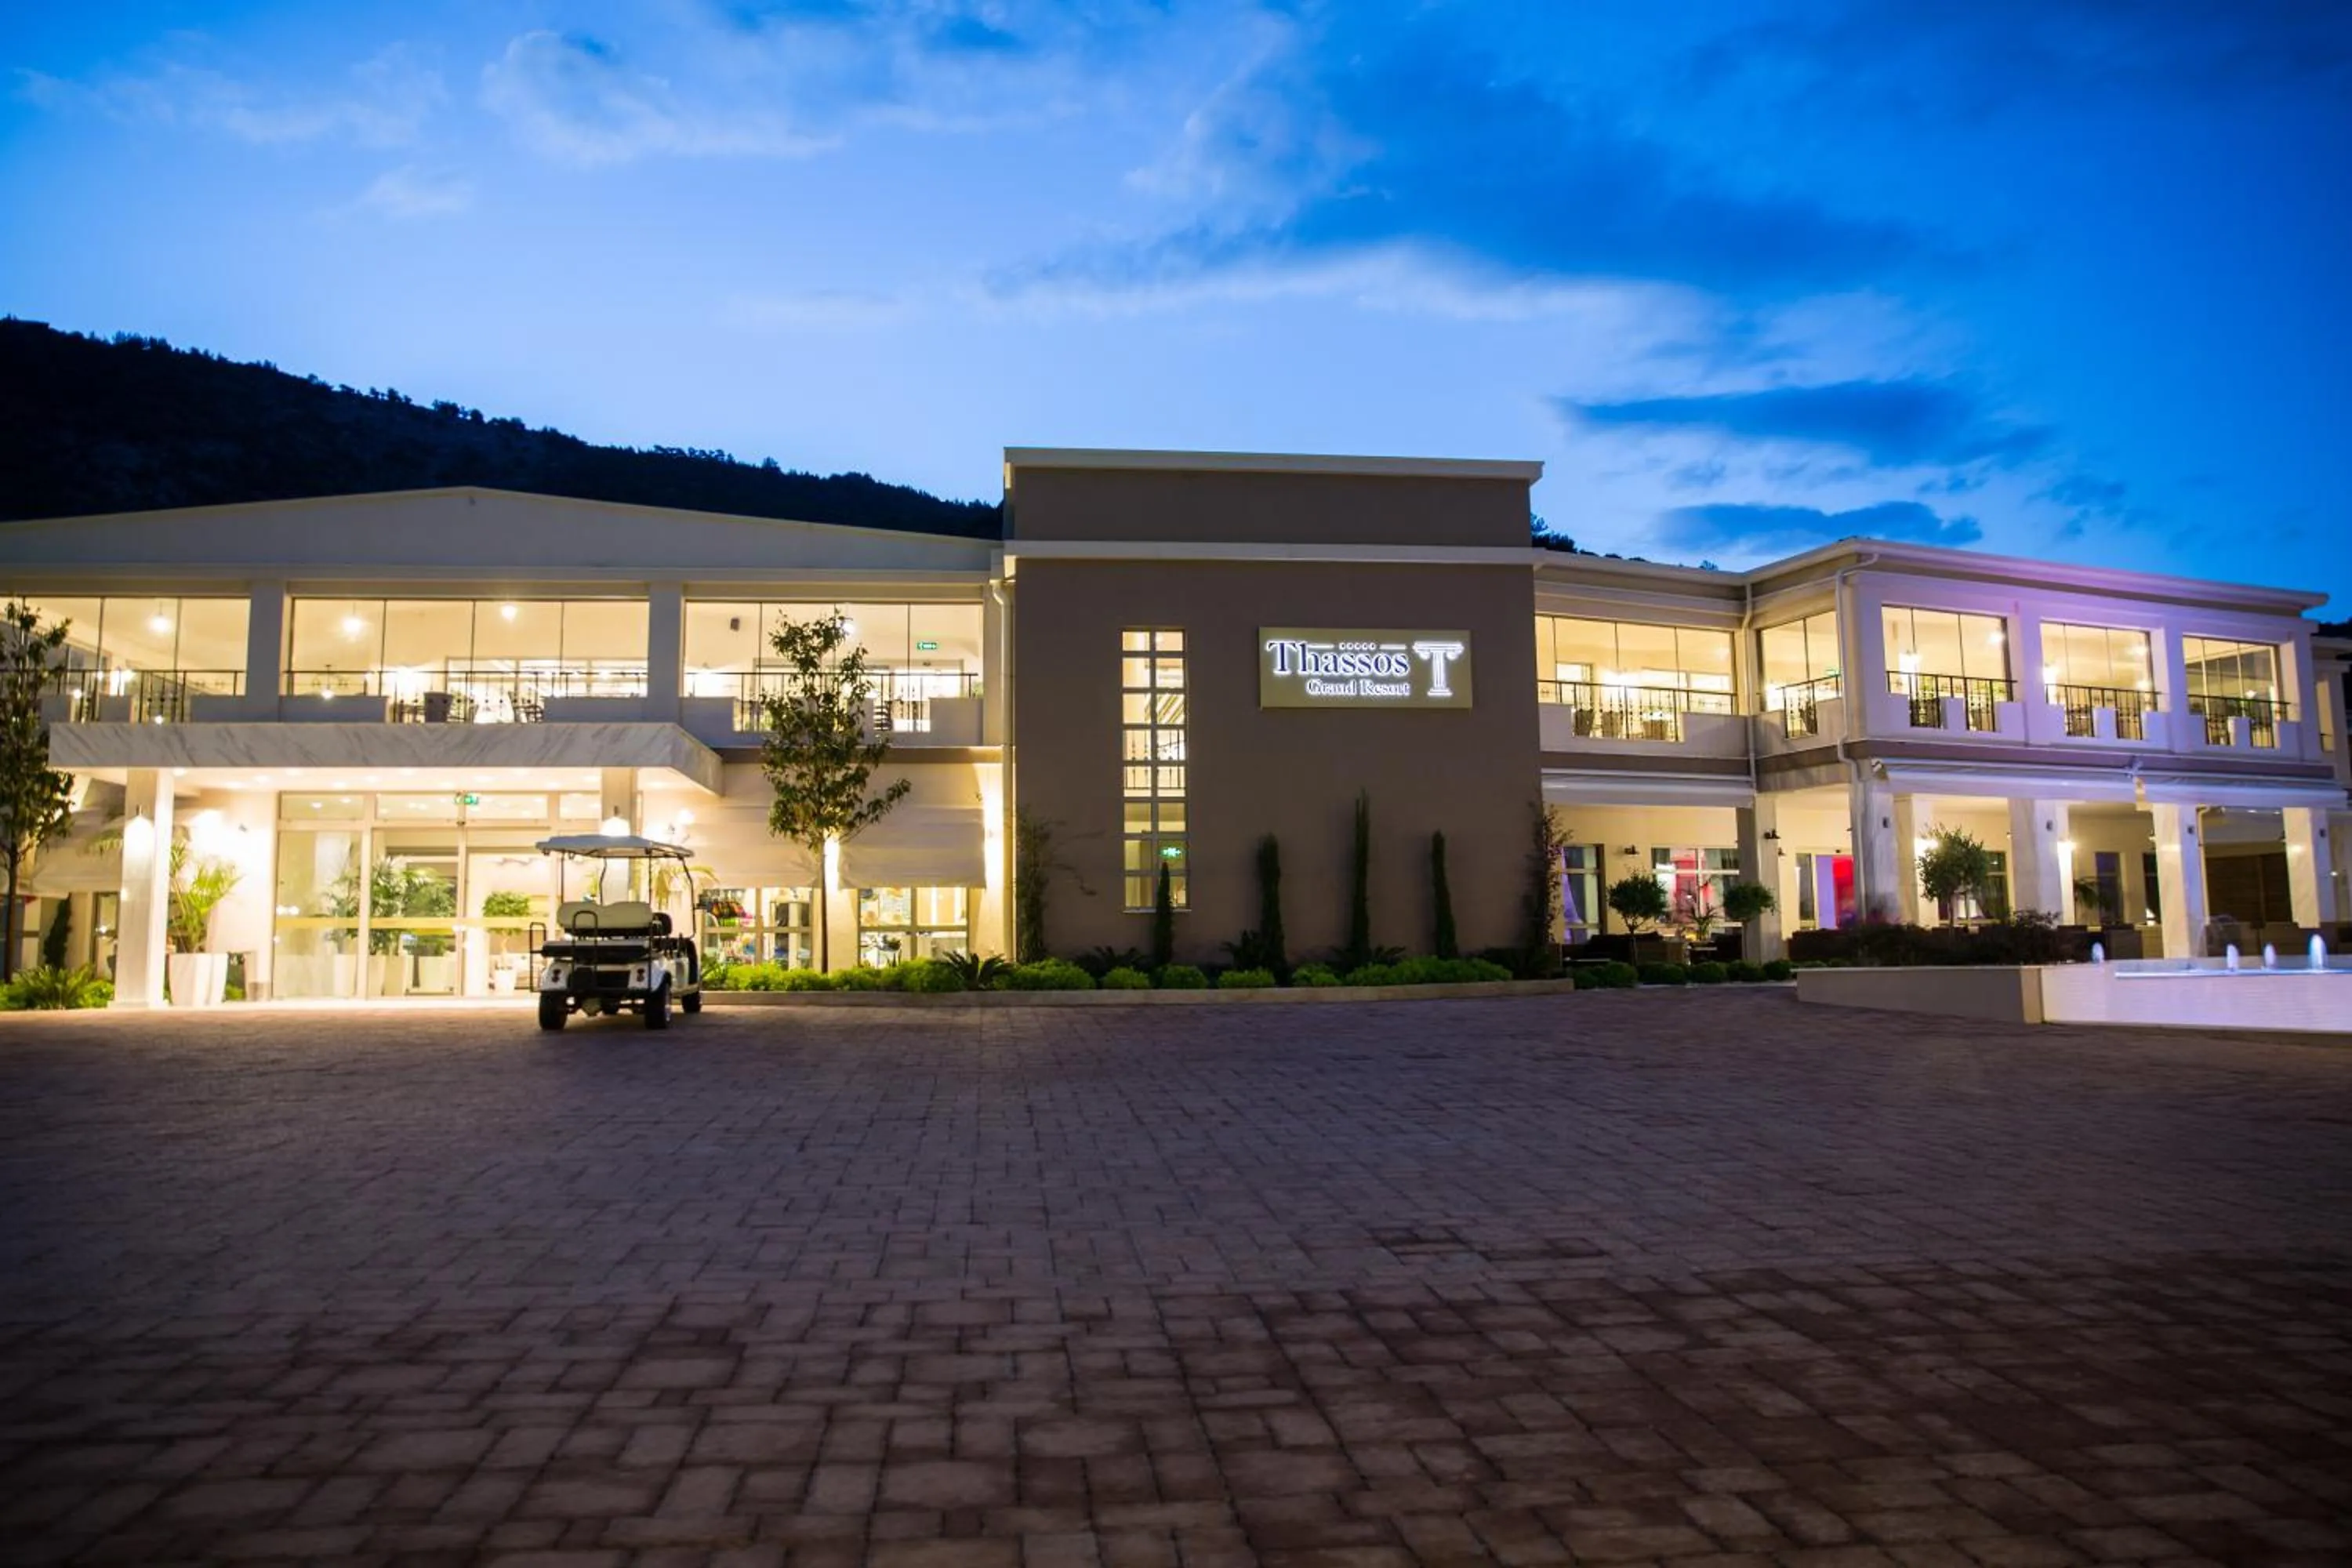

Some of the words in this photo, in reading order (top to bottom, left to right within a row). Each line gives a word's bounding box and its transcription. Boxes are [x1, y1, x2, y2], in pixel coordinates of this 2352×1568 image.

[1265, 640, 1410, 676] Thassos
[1306, 679, 1357, 696] Grand
[1360, 680, 1410, 696] Resort
